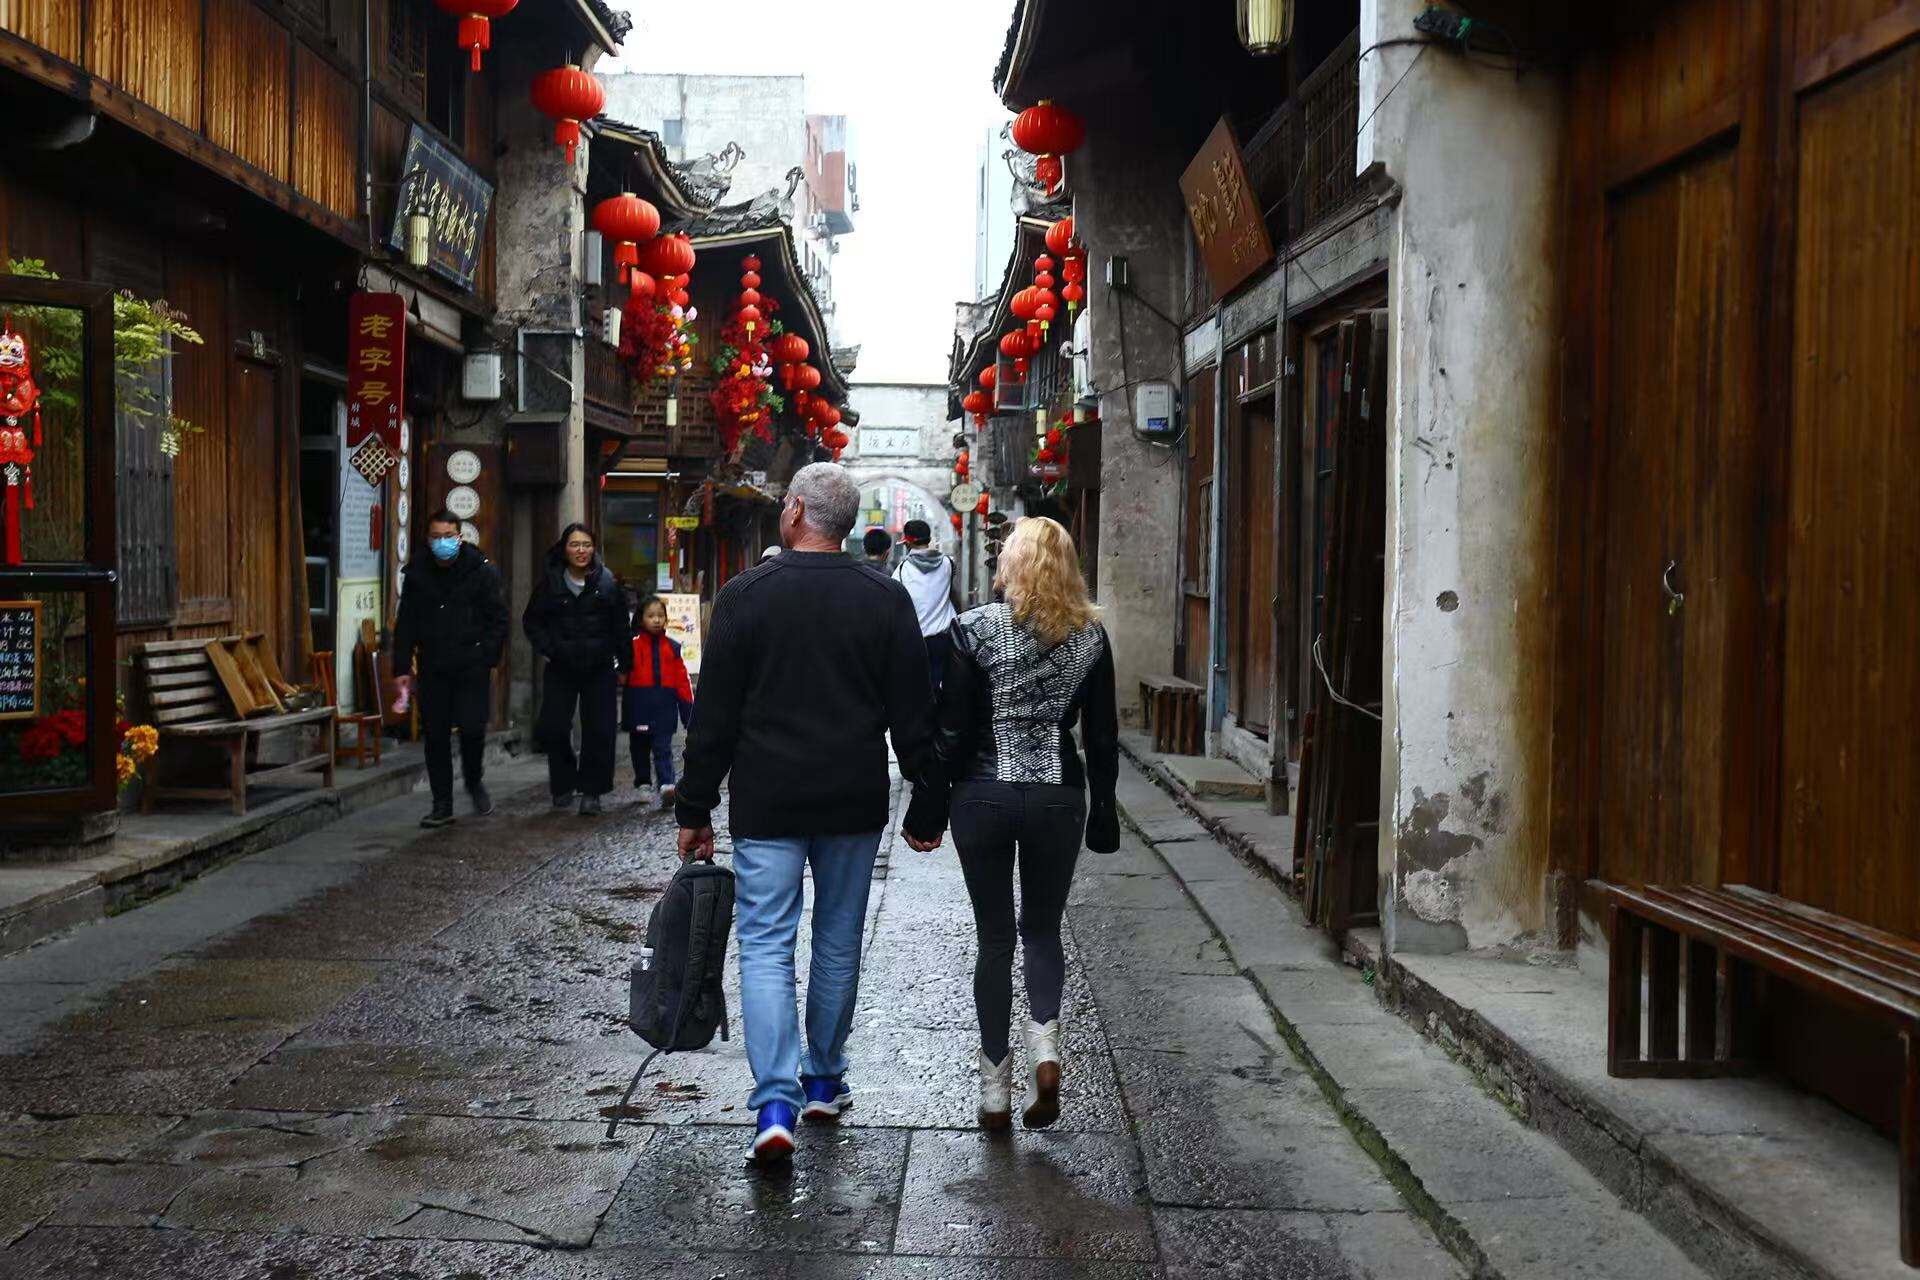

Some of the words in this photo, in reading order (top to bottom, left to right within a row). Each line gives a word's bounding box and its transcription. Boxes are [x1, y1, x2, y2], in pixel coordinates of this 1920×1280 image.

[357, 314, 394, 405] 老字号
[387, 403, 398, 429] 台州
